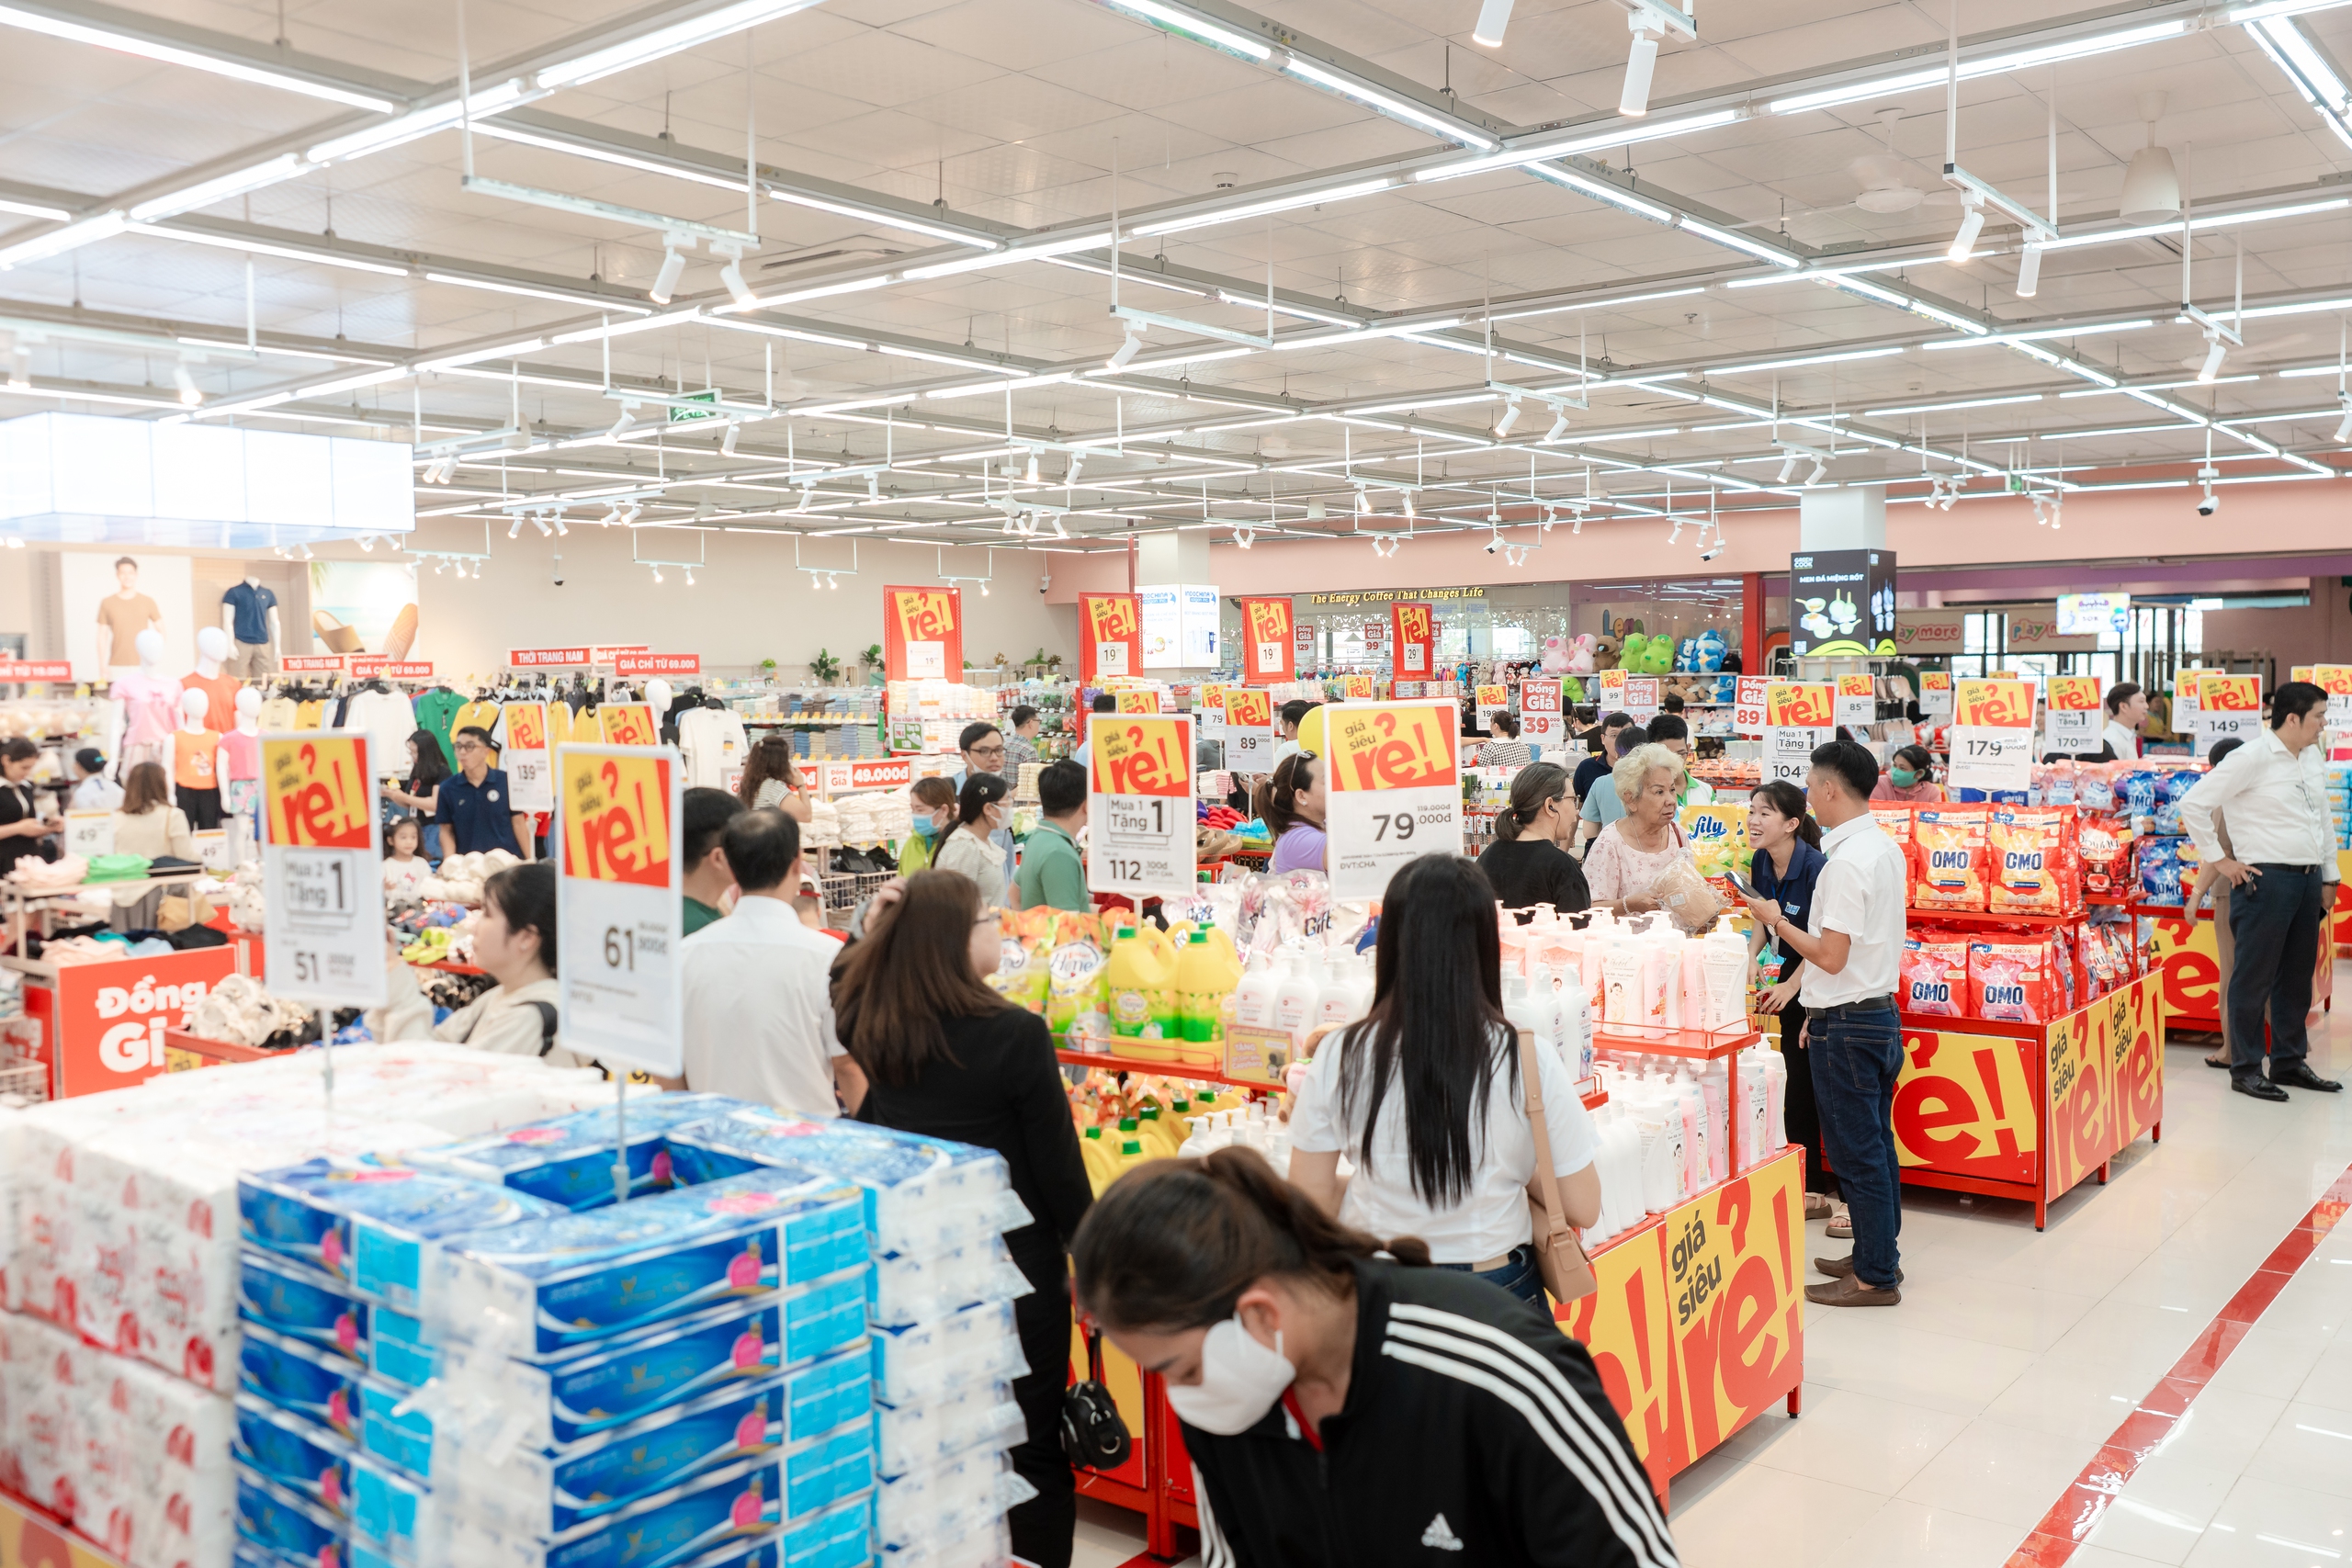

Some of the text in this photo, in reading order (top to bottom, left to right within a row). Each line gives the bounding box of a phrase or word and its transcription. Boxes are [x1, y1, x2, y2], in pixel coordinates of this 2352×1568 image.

[903, 595, 914, 606] giá
[1311, 587, 1484, 604] The Energy Coffee That Changes Life
[906, 605, 919, 615] siêu
[1095, 602, 1103, 612] giá
[1096, 610, 1108, 618] siêu
[908, 592, 947, 641] rẻ!
[1098, 598, 1131, 641] rẻ!
[1257, 604, 1283, 643] rẻ!
[1367, 630, 1382, 638] Giá
[1404, 608, 1424, 644] rẻ!
[2014, 624, 2041, 640] play
[1298, 632, 1312, 640] Giá
[1104, 649, 1116, 661] 19
[1263, 649, 1273, 660] 19
[1366, 642, 1379, 650] 99
[1408, 649, 1417, 660] 29
[303, 659, 324, 669] TRANG
[325, 658, 340, 668] NAM
[518, 650, 583, 663] THỜI TRANG NAM
[620, 656, 695, 670] GIÁ CHỈ TỪ 69.000
[356, 664, 373, 674] GIÁ
[391, 664, 403, 674] TỪ
[403, 666, 430, 674] 69.000
[1351, 677, 1370, 697] rẻ!
[1526, 682, 1556, 695] Đồng
[1605, 671, 1623, 688] rẻ!
[1628, 682, 1653, 691] Đồng
[1845, 677, 1867, 696] rẻ!
[1926, 673, 1945, 690] rẻ!
[1483, 686, 1502, 705] rẻ!
[1628, 693, 1652, 705] Giá
[1776, 689, 1787, 698] giá
[1967, 687, 1980, 696] giá
[1968, 695, 1985, 704] siêu
[2057, 680, 2093, 710] rẻ!
[2211, 680, 2250, 710] rẻ!
[1233, 693, 1264, 726] rẻ!
[1527, 694, 1555, 710] Giá
[1777, 697, 1792, 705] siêu
[1778, 685, 1821, 726] rẻ!
[1969, 683, 2019, 727] rẻ!
[1524, 717, 1550, 733] 39
[1736, 709, 1760, 725] 89
[2079, 711, 2086, 726] 1
[2210, 720, 2239, 732] 149
[514, 707, 540, 749] rẻ!
[1344, 718, 1366, 738] giá
[1104, 730, 1120, 746] giá
[1240, 738, 1257, 750] 89
[1350, 734, 1376, 750] siêu
[1779, 739, 1804, 750] Tặng
[1806, 730, 1815, 750] 1
[2057, 738, 2078, 747] 170
[1107, 744, 1128, 758] siêu
[1351, 712, 1435, 791] rẻ!
[1967, 739, 2003, 757] 179
[1109, 725, 1172, 795] rẻ!
[853, 765, 910, 783] 49.000đ
[1773, 765, 1801, 778] 104
[282, 743, 352, 846] rẻ!
[1111, 799, 1143, 811] Mua 1
[582, 761, 651, 880] rẻ!
[1111, 813, 1148, 832] Tặng
[1151, 799, 1163, 833] 1
[1372, 812, 1452, 842] 79 .000đ
[1688, 816, 1727, 840] fily
[202, 846, 217, 858] 49
[1932, 851, 1969, 869] OMO
[2006, 852, 2042, 870] OMO
[1109, 859, 1142, 881] 112
[331, 861, 344, 909] 1
[604, 926, 635, 972] 61
[295, 951, 320, 983] 51
[96, 975, 208, 1019] Đồng
[1912, 981, 1949, 1002] OMO
[1984, 985, 2023, 1005] OMO
[2112, 994, 2126, 1037] giá
[99, 1016, 168, 1074] Gi
[2051, 1026, 2068, 1073] giá
[2116, 1024, 2132, 1064] siêu
[2117, 980, 2163, 1151] rẻ!
[2053, 1057, 2075, 1101] siêu
[2055, 1010, 2110, 1195] rẻ!
[1671, 1209, 1707, 1284] giá
[1679, 1254, 1723, 1326] siêu
[1681, 1177, 1799, 1458] rẻ!
